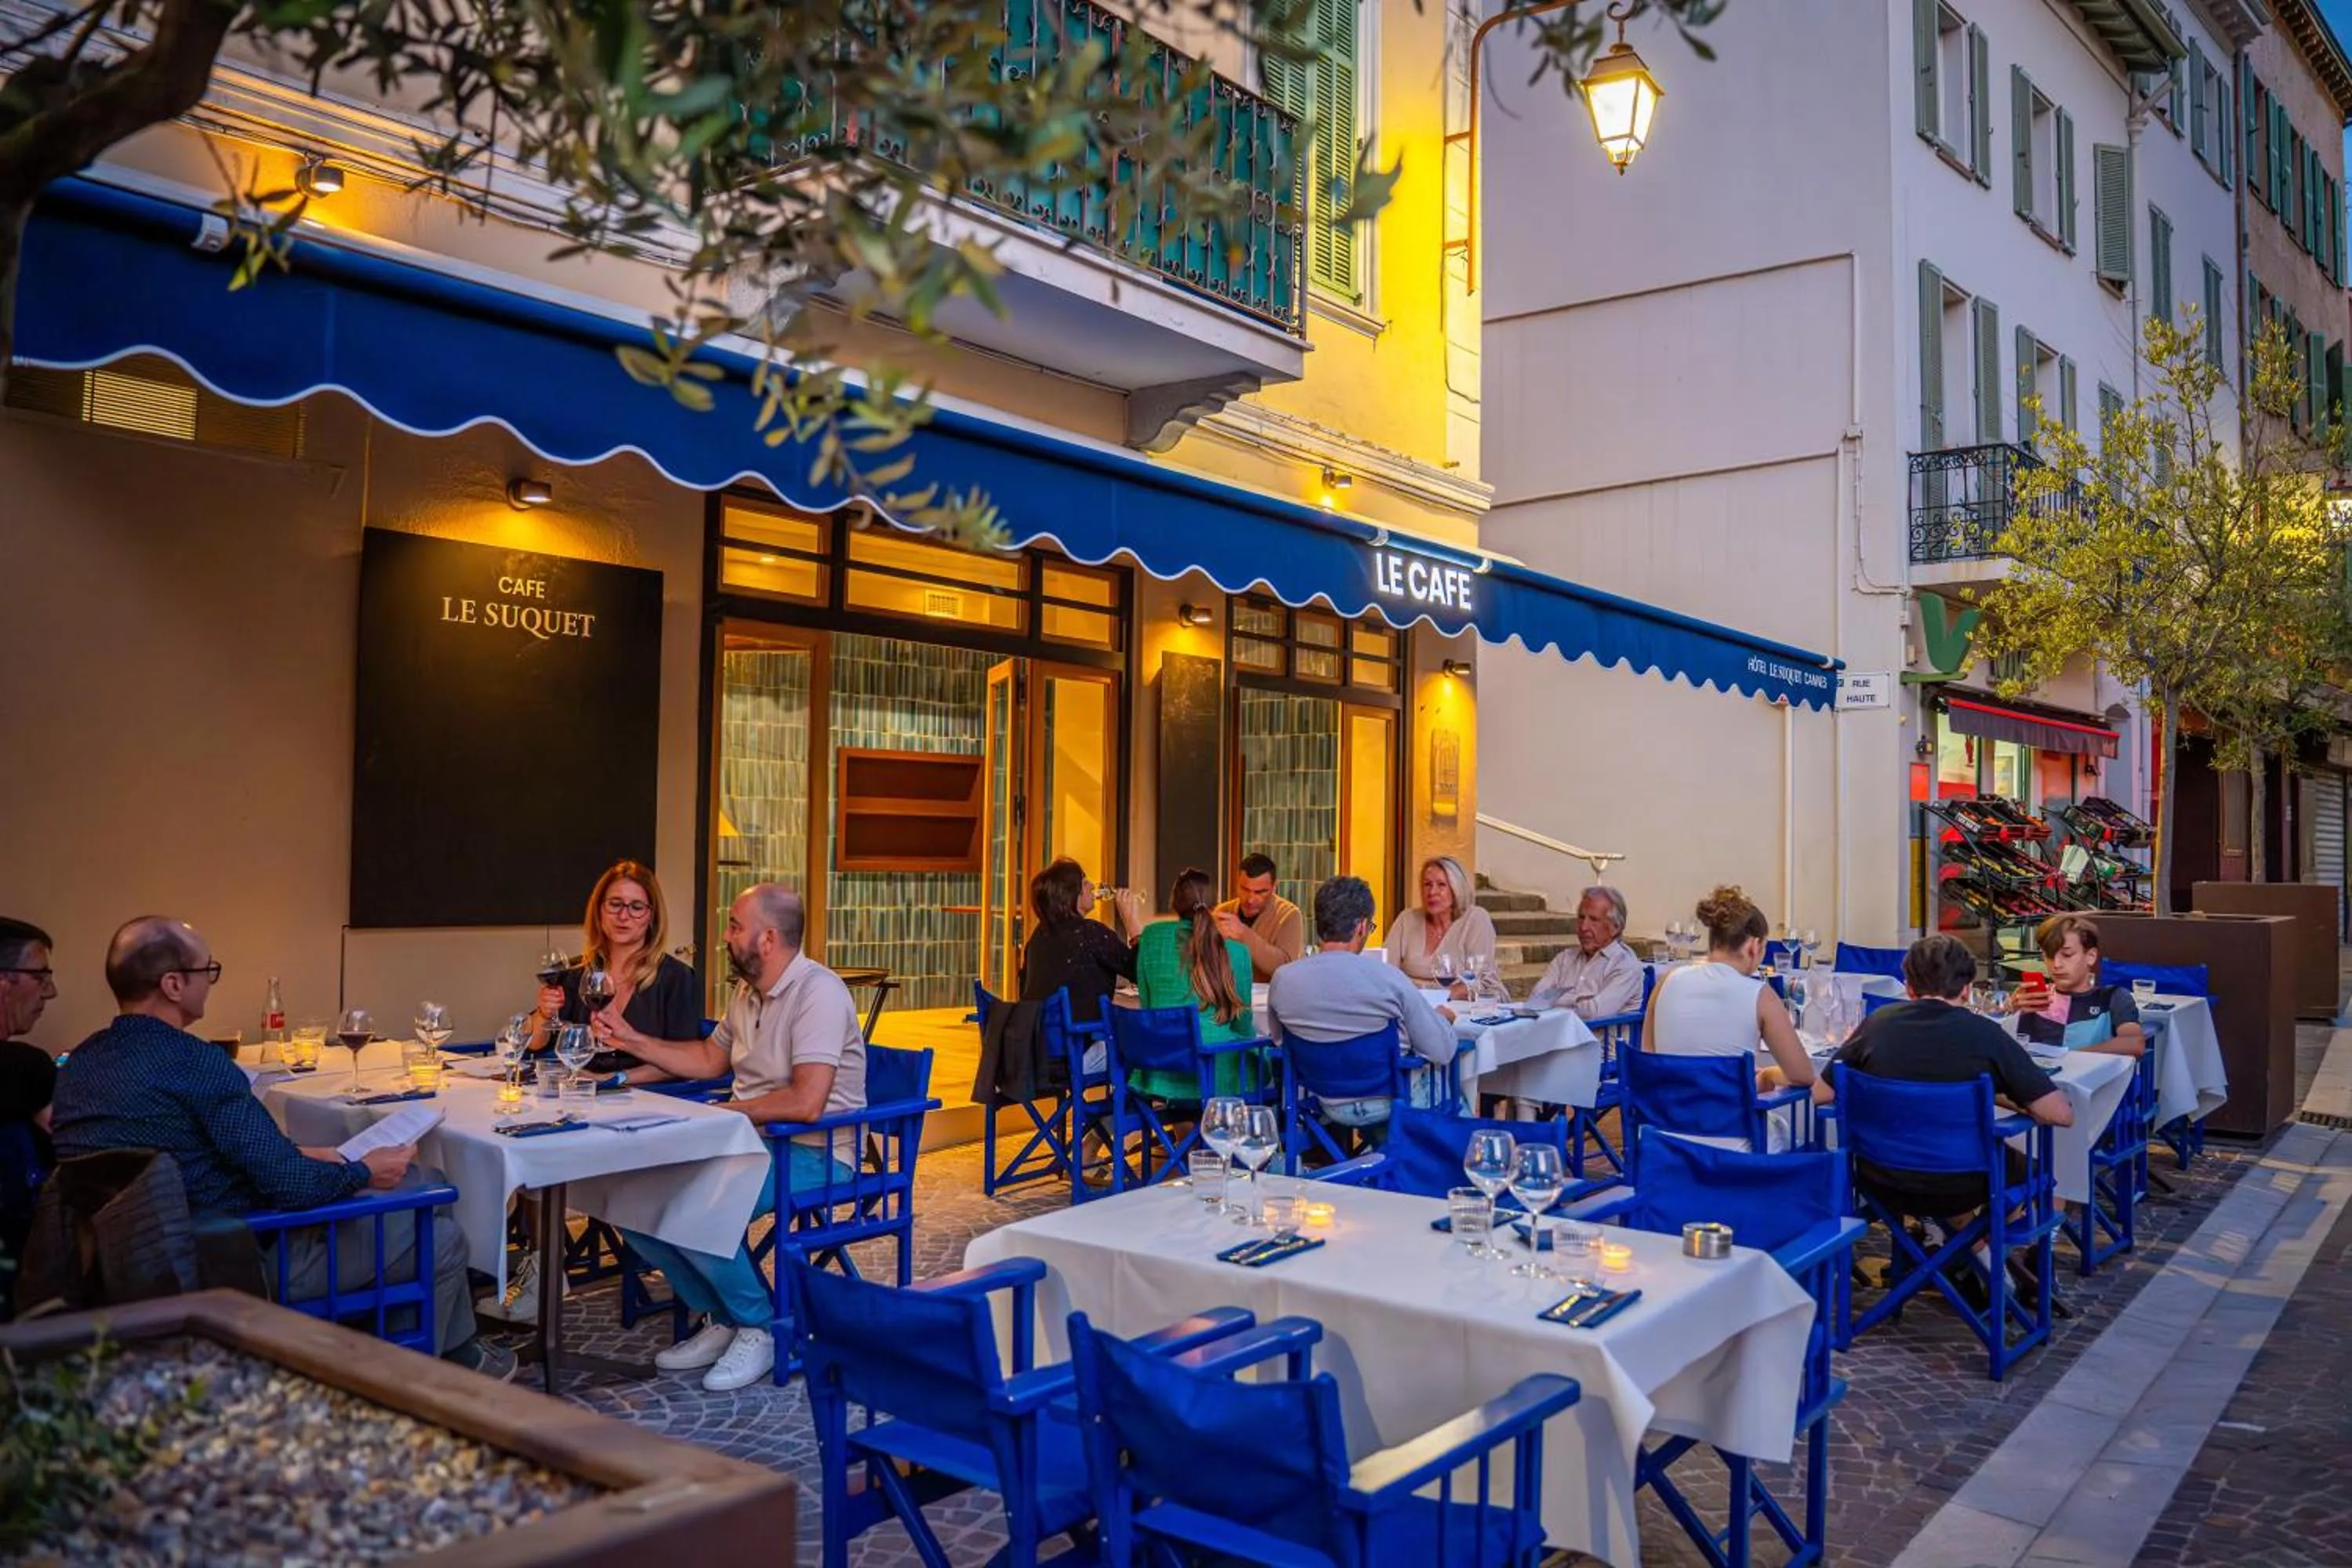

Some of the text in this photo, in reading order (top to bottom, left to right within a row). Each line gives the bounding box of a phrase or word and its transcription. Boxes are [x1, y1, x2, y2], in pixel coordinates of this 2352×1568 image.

[498, 575, 546, 599] CAFE
[1376, 552, 1472, 610] LE CAFE
[441, 597, 596, 640] LE SUQUET
[1769, 662, 1777, 678] LE
[1846, 694, 1876, 703] HAUTE
